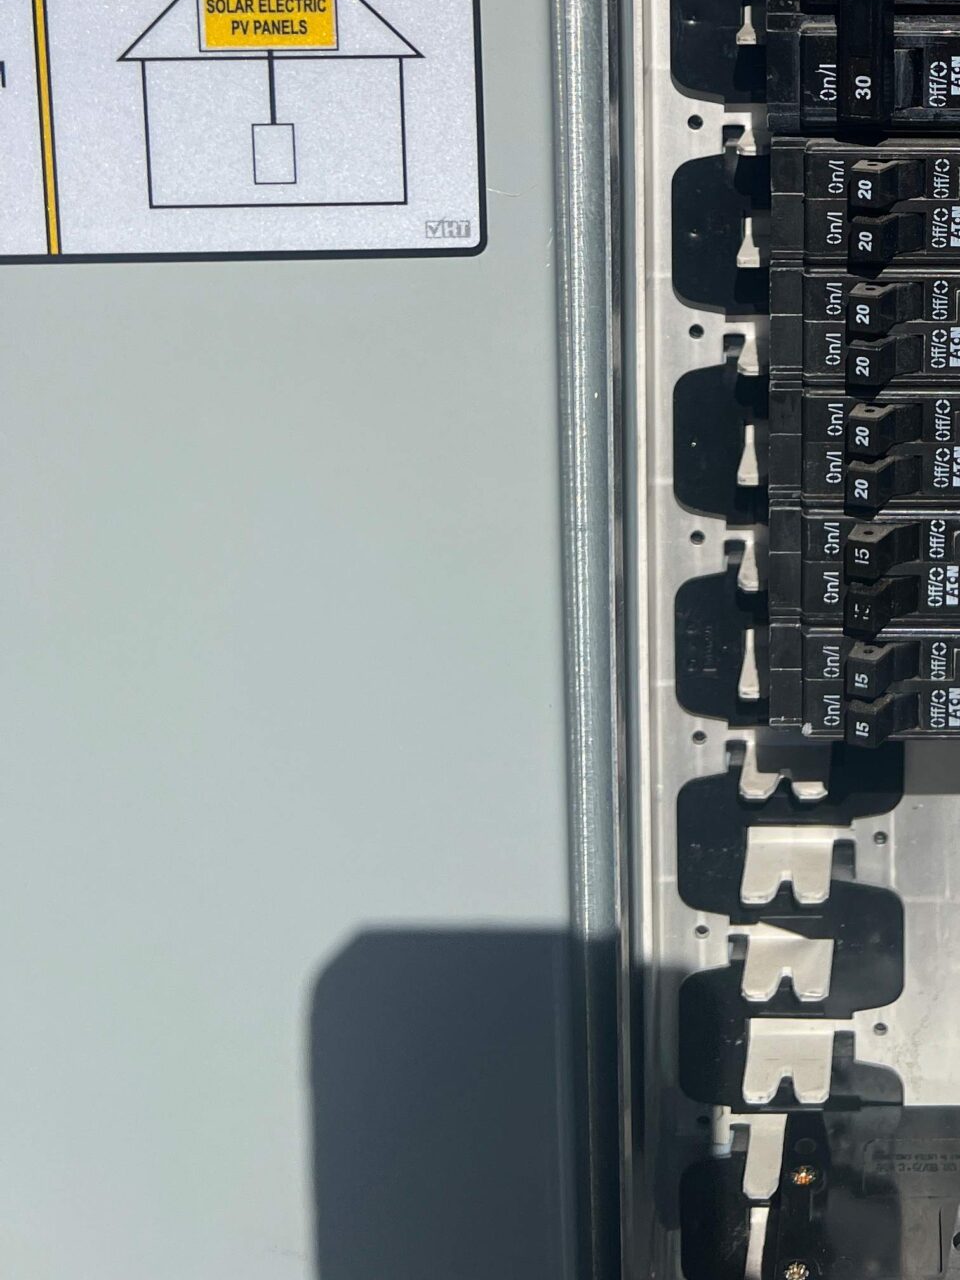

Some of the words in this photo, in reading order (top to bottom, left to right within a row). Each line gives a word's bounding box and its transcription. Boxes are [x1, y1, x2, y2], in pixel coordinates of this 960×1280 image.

[230, 20, 250, 37] PV
[254, 20, 308, 36] PANELS
[855, 75, 872, 100] 30
[858, 180, 872, 200] 20
[858, 231, 872, 251] 20
[856, 305, 869, 324] 20
[856, 356, 869, 376] 20
[856, 426, 869, 446] 20
[855, 479, 868, 499] 20
[855, 549, 869, 564] 15
[946, 566, 959, 605] EATON
[855, 674, 868, 688] 15
[949, 688, 960, 726] EATON
[856, 722, 869, 736] 15
